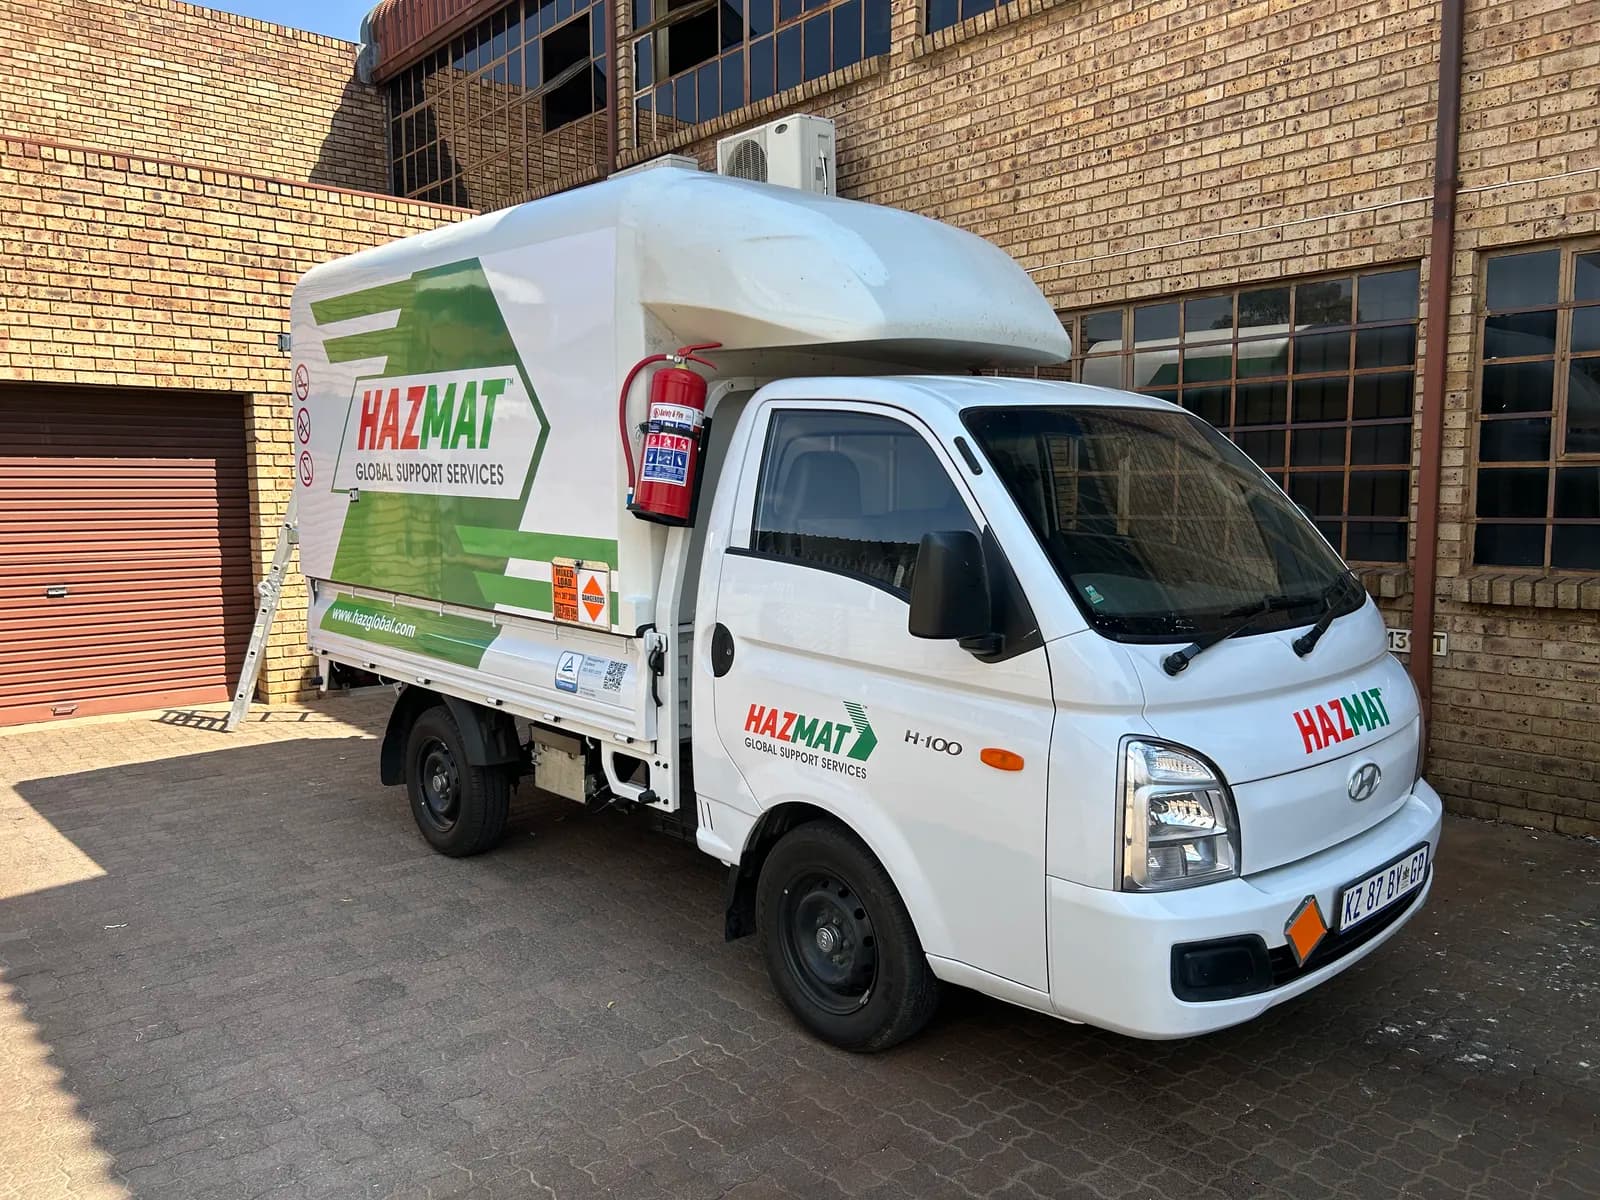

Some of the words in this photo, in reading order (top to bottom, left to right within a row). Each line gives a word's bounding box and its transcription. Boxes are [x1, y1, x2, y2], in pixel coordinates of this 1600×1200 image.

[357, 378, 507, 450] HAZMAT
[356, 463, 393, 481] GLOBAL
[397, 463, 443, 483] SUPPORT
[446, 463, 504, 485] SERVICES
[558, 576, 572, 587] LOAD
[582, 593, 605, 604] DANGEROUS
[332, 607, 417, 638] www.hazglobal.com
[744, 703, 852, 754] HAZMAT
[1293, 687, 1390, 754] HAZMAT
[744, 737, 778, 755] GLOBAL
[780, 747, 819, 766] SUPPORT
[821, 757, 867, 779] SERVICES
[904, 729, 963, 756] H-100
[1345, 887, 1363, 924] KZ
[1367, 876, 1384, 911] 87
[1387, 865, 1403, 900] BY
[1410, 852, 1424, 884] GP
